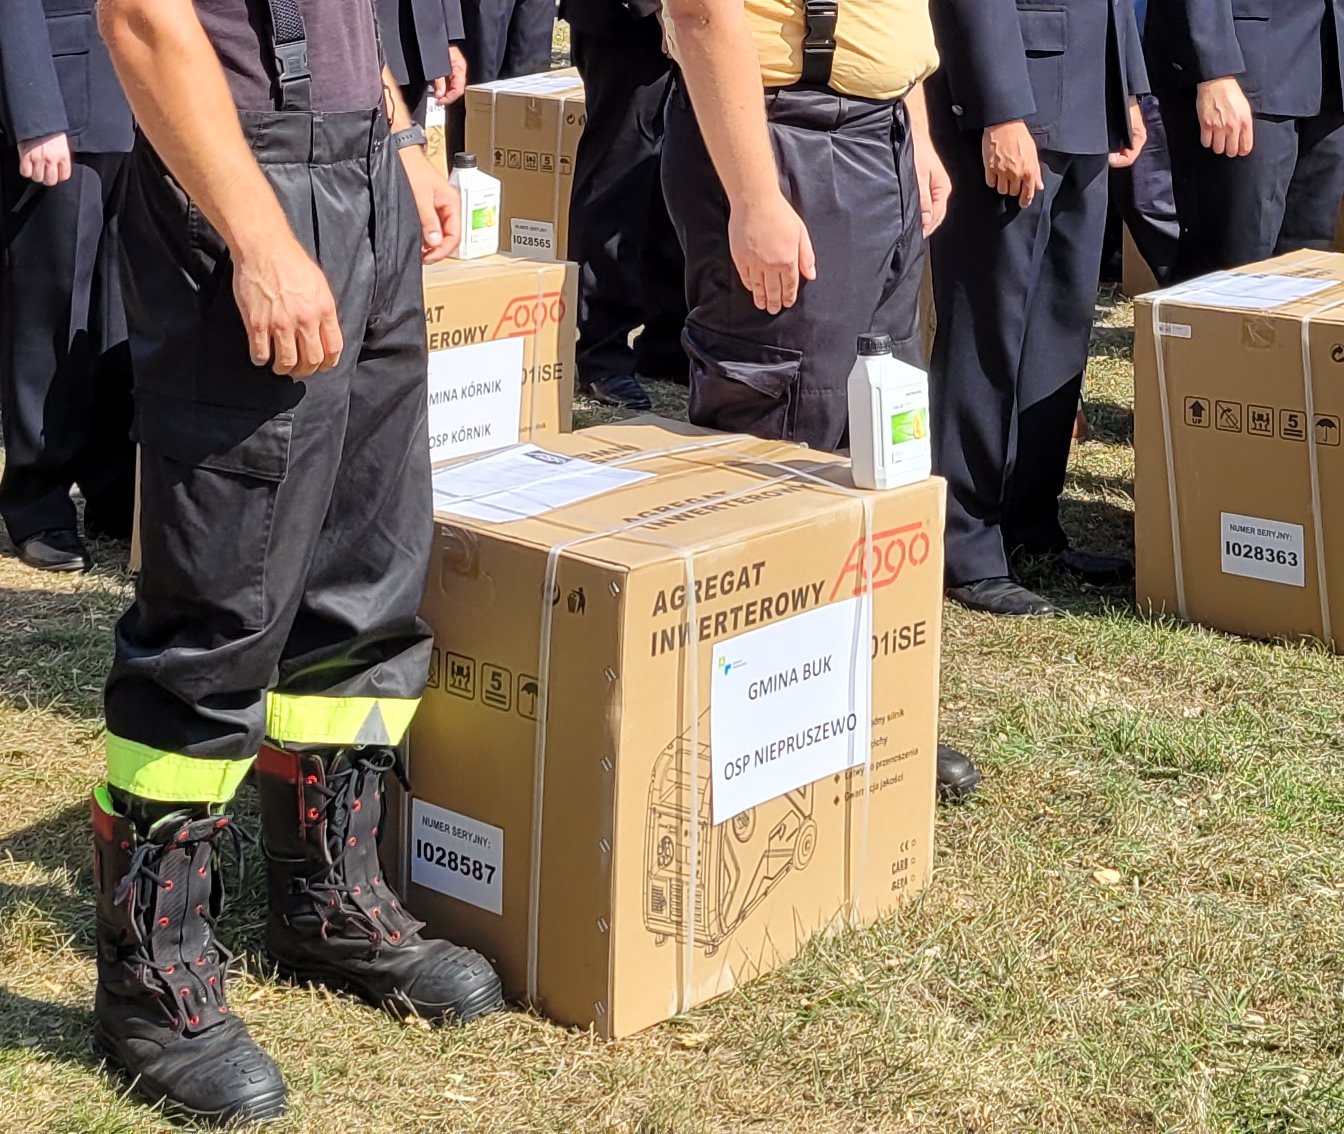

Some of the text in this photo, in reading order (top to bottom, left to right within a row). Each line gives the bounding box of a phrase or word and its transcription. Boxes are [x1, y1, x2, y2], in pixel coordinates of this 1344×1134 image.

[428, 379, 503, 407] MINA KÓRNIK
[451, 422, 492, 445] KÓRNIK
[1229, 523, 1256, 536] NUMER
[1225, 540, 1299, 568] I028363
[651, 560, 766, 617] AGREGAT
[650, 579, 825, 658] INWERTEROWY
[747, 654, 833, 701] GMINA BUK
[723, 711, 858, 782] OSP NIEPRUSZEWO
[421, 815, 491, 850] NUMER SERYJNY:
[415, 838, 497, 885] I028587
